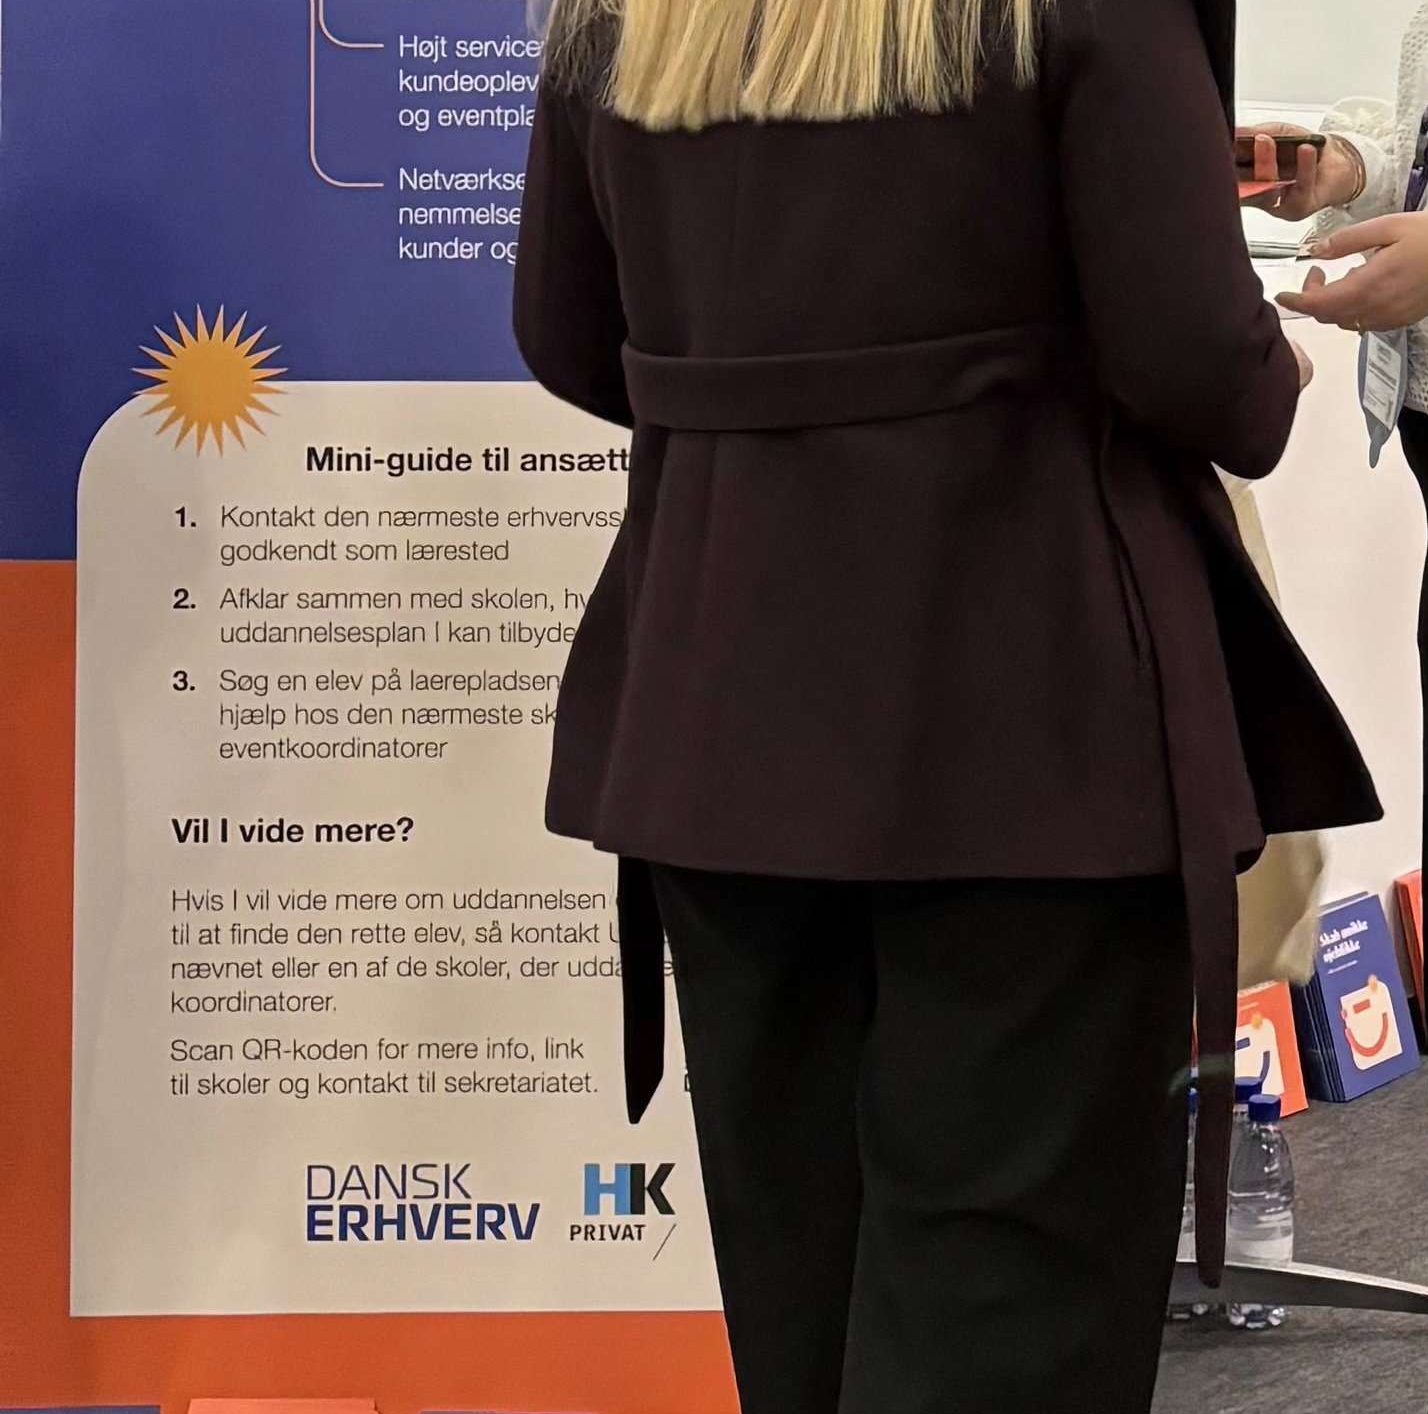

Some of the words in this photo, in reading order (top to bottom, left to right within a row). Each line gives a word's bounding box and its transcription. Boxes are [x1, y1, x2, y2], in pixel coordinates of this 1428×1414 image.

[399, 34, 448, 64] Højt
[398, 108, 430, 132] og
[399, 236, 484, 260] kunder
[306, 446, 473, 478] Mini-guide
[481, 446, 510, 472] til
[175, 506, 197, 528] 1.
[221, 505, 316, 528] Kontakt
[324, 505, 369, 528] den
[378, 507, 499, 528] nærmeste
[508, 507, 626, 527] erhvervss
[220, 538, 337, 567] godkendt
[345, 543, 398, 561] som
[406, 538, 509, 561] lærested
[172, 587, 196, 610] 2.
[219, 587, 289, 610] Afklar
[296, 592, 402, 610] sammen
[410, 587, 463, 609] med
[470, 587, 555, 613] skolen,
[220, 620, 426, 648] uddannelsesplan
[448, 620, 491, 643] kan
[499, 622, 575, 648] tilbyde
[172, 670, 196, 692] 3.
[219, 669, 269, 697] Søg
[277, 674, 307, 692] en
[315, 669, 364, 692] elev
[371, 667, 402, 696] på
[219, 703, 286, 731] hjælp
[295, 703, 339, 725] hos
[347, 702, 393, 725] den
[401, 705, 523, 725] nærmeste
[219, 736, 449, 759] eventkoordinatorer
[171, 817, 209, 844] Vil
[238, 817, 305, 843] vide
[315, 816, 414, 843] mere?
[172, 889, 224, 912] Hvis
[246, 888, 270, 911] vil
[277, 889, 327, 911] vide
[335, 893, 397, 911] mere
[405, 893, 444, 910] om
[453, 887, 606, 911] uddannelsen
[171, 922, 190, 946] til
[198, 923, 221, 946] at
[230, 922, 289, 945] finde
[296, 922, 342, 945] den
[351, 923, 406, 944] rette
[414, 922, 466, 947] elev,
[474, 920, 503, 944] så
[511, 921, 600, 944] kontakt
[171, 958, 263, 980] nævnet
[271, 956, 321, 979] eller
[328, 961, 358, 979] en
[366, 955, 390, 978] af
[396, 955, 428, 978] de
[435, 955, 511, 980] skoler,
[519, 956, 560, 978] der
[171, 990, 337, 1014] koordinatorer.
[170, 1039, 233, 1062] Scan
[242, 1038, 368, 1061] QR-koden
[377, 1037, 410, 1061] for
[417, 1042, 479, 1060] mere
[486, 1036, 535, 1062] info,
[545, 1036, 585, 1060] link
[170, 1073, 189, 1096] til
[197, 1072, 271, 1096] skoler
[278, 1077, 309, 1100] og
[318, 1071, 409, 1095] kontakt
[418, 1070, 436, 1093] til
[444, 1070, 598, 1094] sekretariatet.
[306, 1163, 472, 1201] DANSK
[584, 1163, 676, 1215] HK
[306, 1202, 541, 1242] ERHVERV
[569, 1224, 646, 1242] PRIVAT
